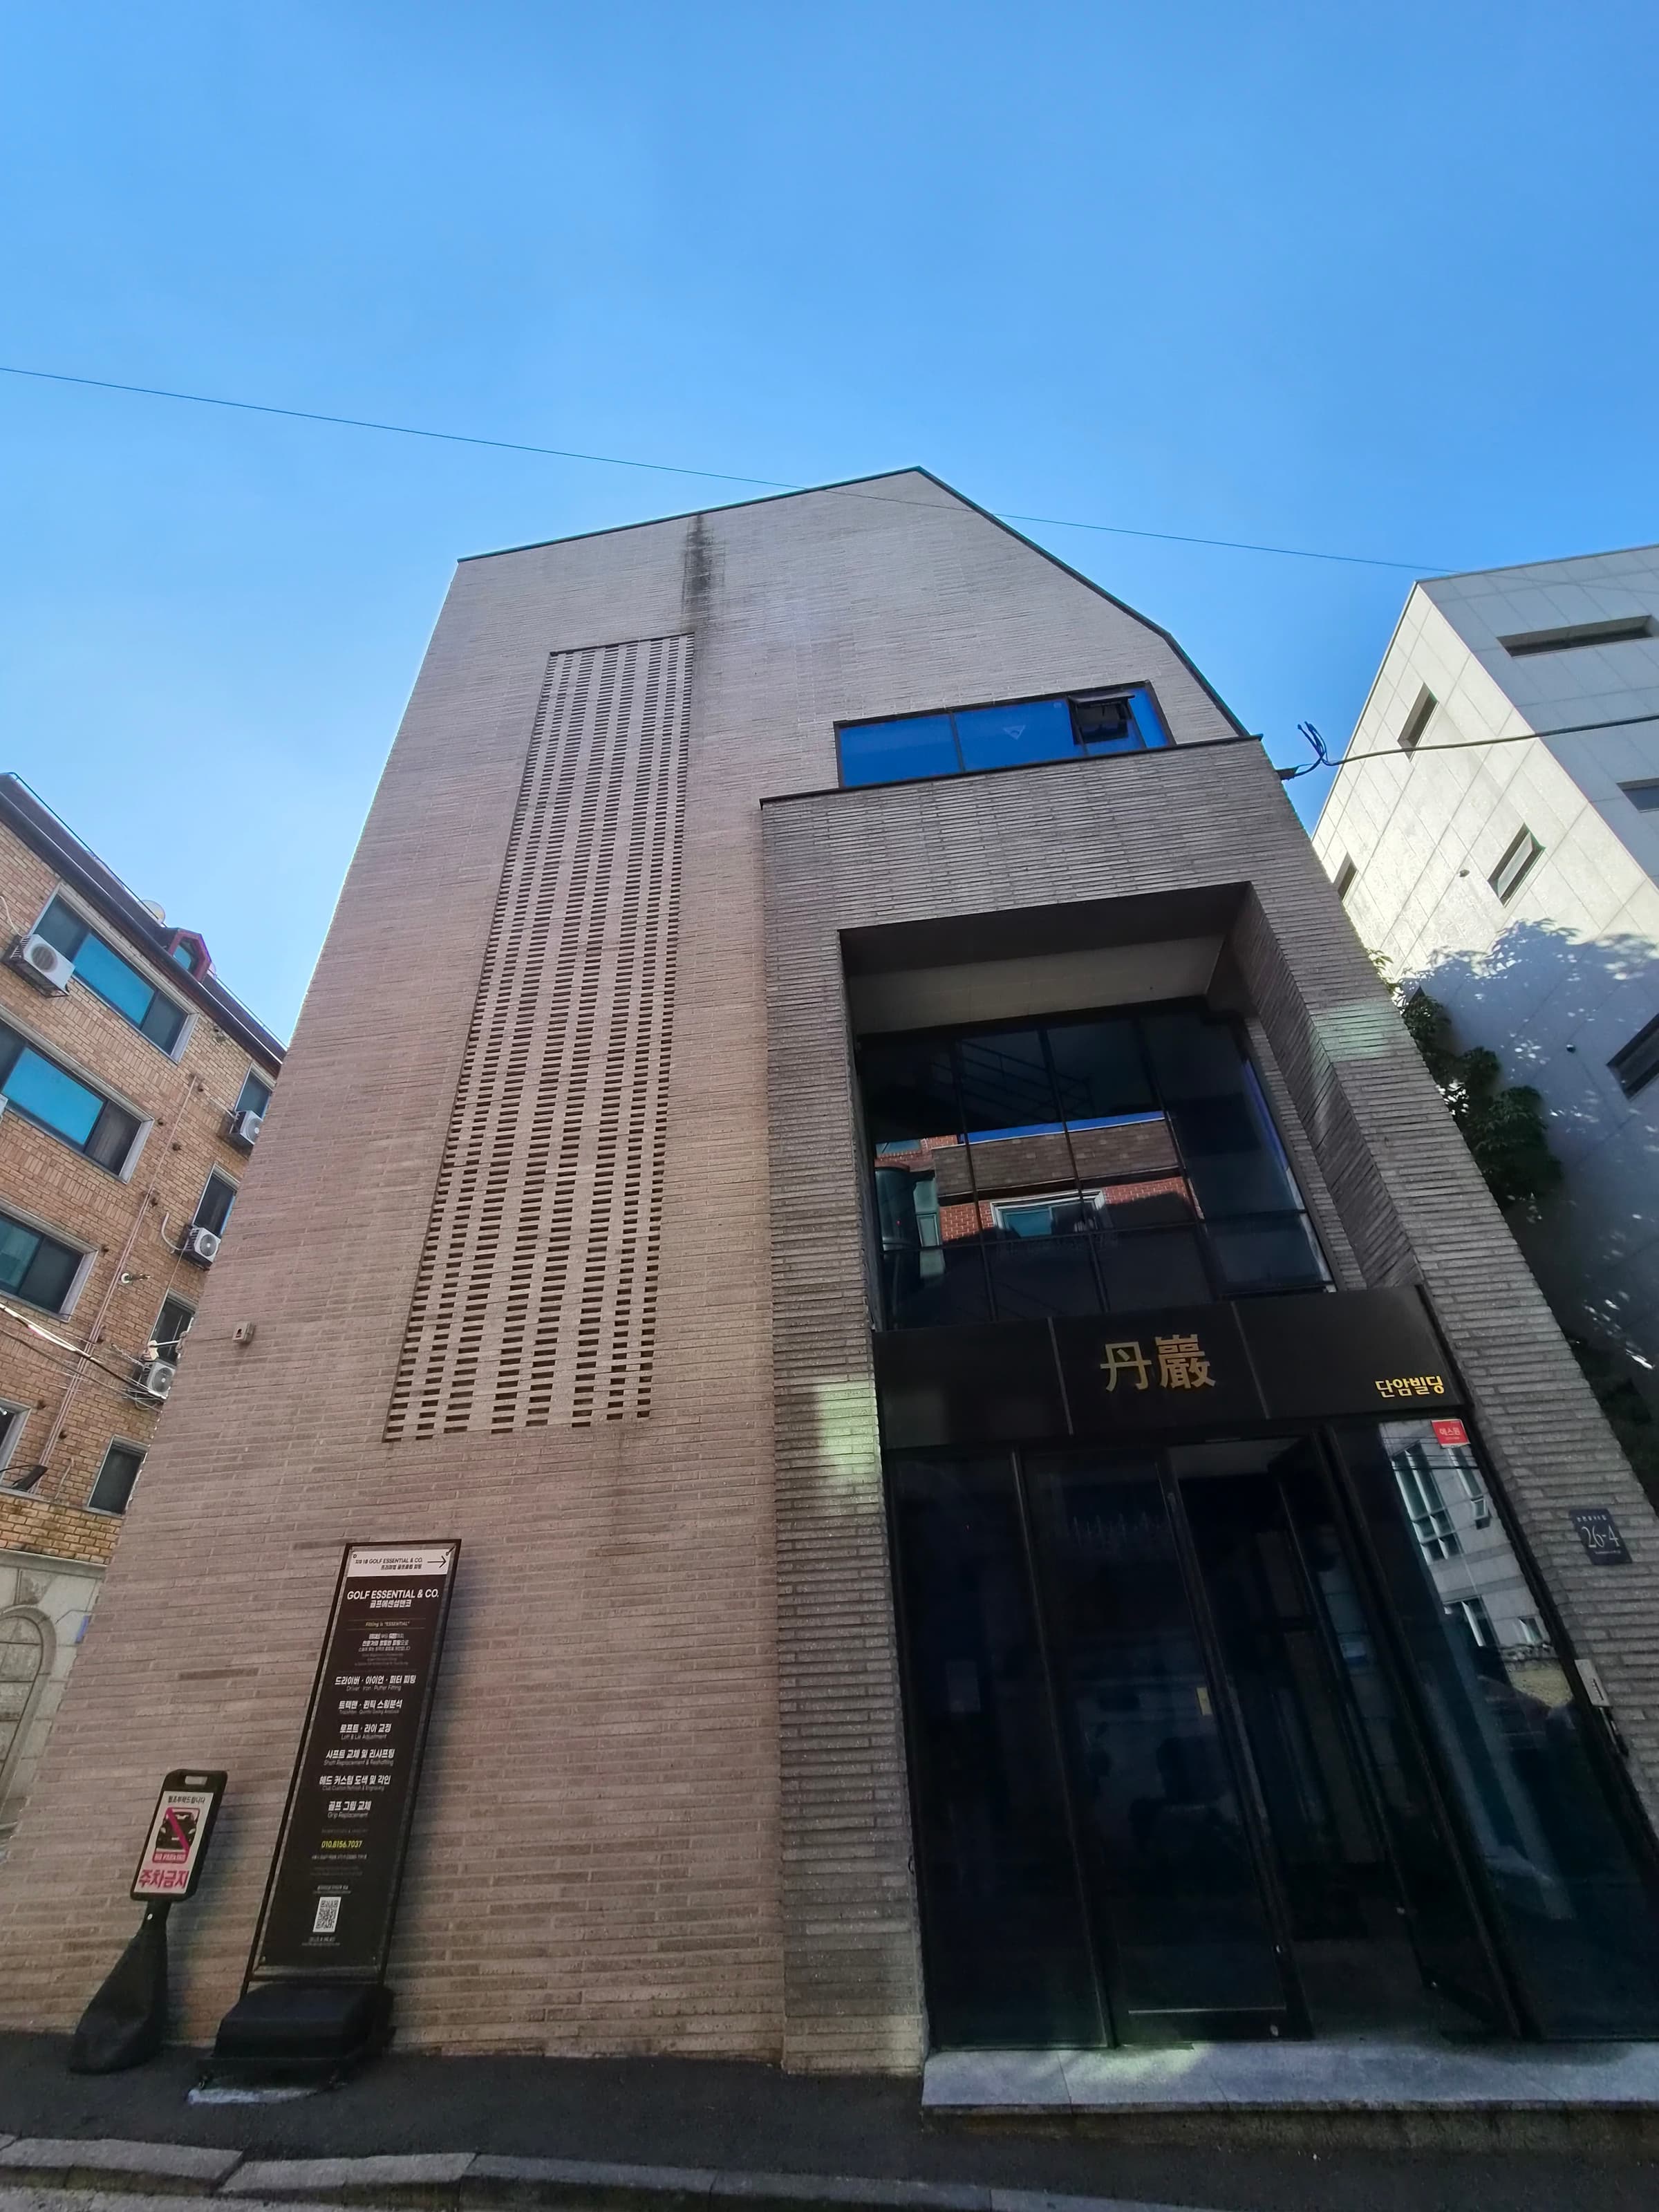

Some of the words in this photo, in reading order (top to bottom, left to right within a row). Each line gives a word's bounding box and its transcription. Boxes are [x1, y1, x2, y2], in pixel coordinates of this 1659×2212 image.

[1100, 1333, 1216, 1391] 丹巖
[1375, 1376, 1445, 1398] 단암빌딩
[1581, 1525, 1620, 1548] 26-4
[347, 1590, 371, 1600] GOLF
[371, 1588, 415, 1600] ESSENTIAL
[417, 1589, 423, 1598] &
[424, 1588, 440, 1598] CO.
[335, 1676, 360, 1685] 드라이버
[365, 1675, 384, 1685] 아이언
[389, 1675, 402, 1684] 퍼터
[403, 1674, 416, 1684] 피팅
[338, 1700, 359, 1709] 트랙맨
[377, 1699, 403, 1709] 스윙분석
[339, 1723, 359, 1733] 로프트
[364, 1723, 377, 1733] 라이
[378, 1723, 392, 1733] 교정
[346, 1749, 360, 1759] 교체
[361, 1749, 368, 1759] 및
[319, 1774, 333, 1785] 헤드
[333, 1774, 354, 1785] 커스텀
[354, 1774, 368, 1785] 도색
[369, 1774, 377, 1785] 및
[377, 1774, 391, 1785] 각인
[328, 1801, 342, 1811] 골프
[343, 1801, 357, 1811] 그립
[357, 1800, 372, 1810] 교체
[321, 1840, 363, 1848] 010.8156.7037
[139, 1868, 189, 1888] 주차금지
